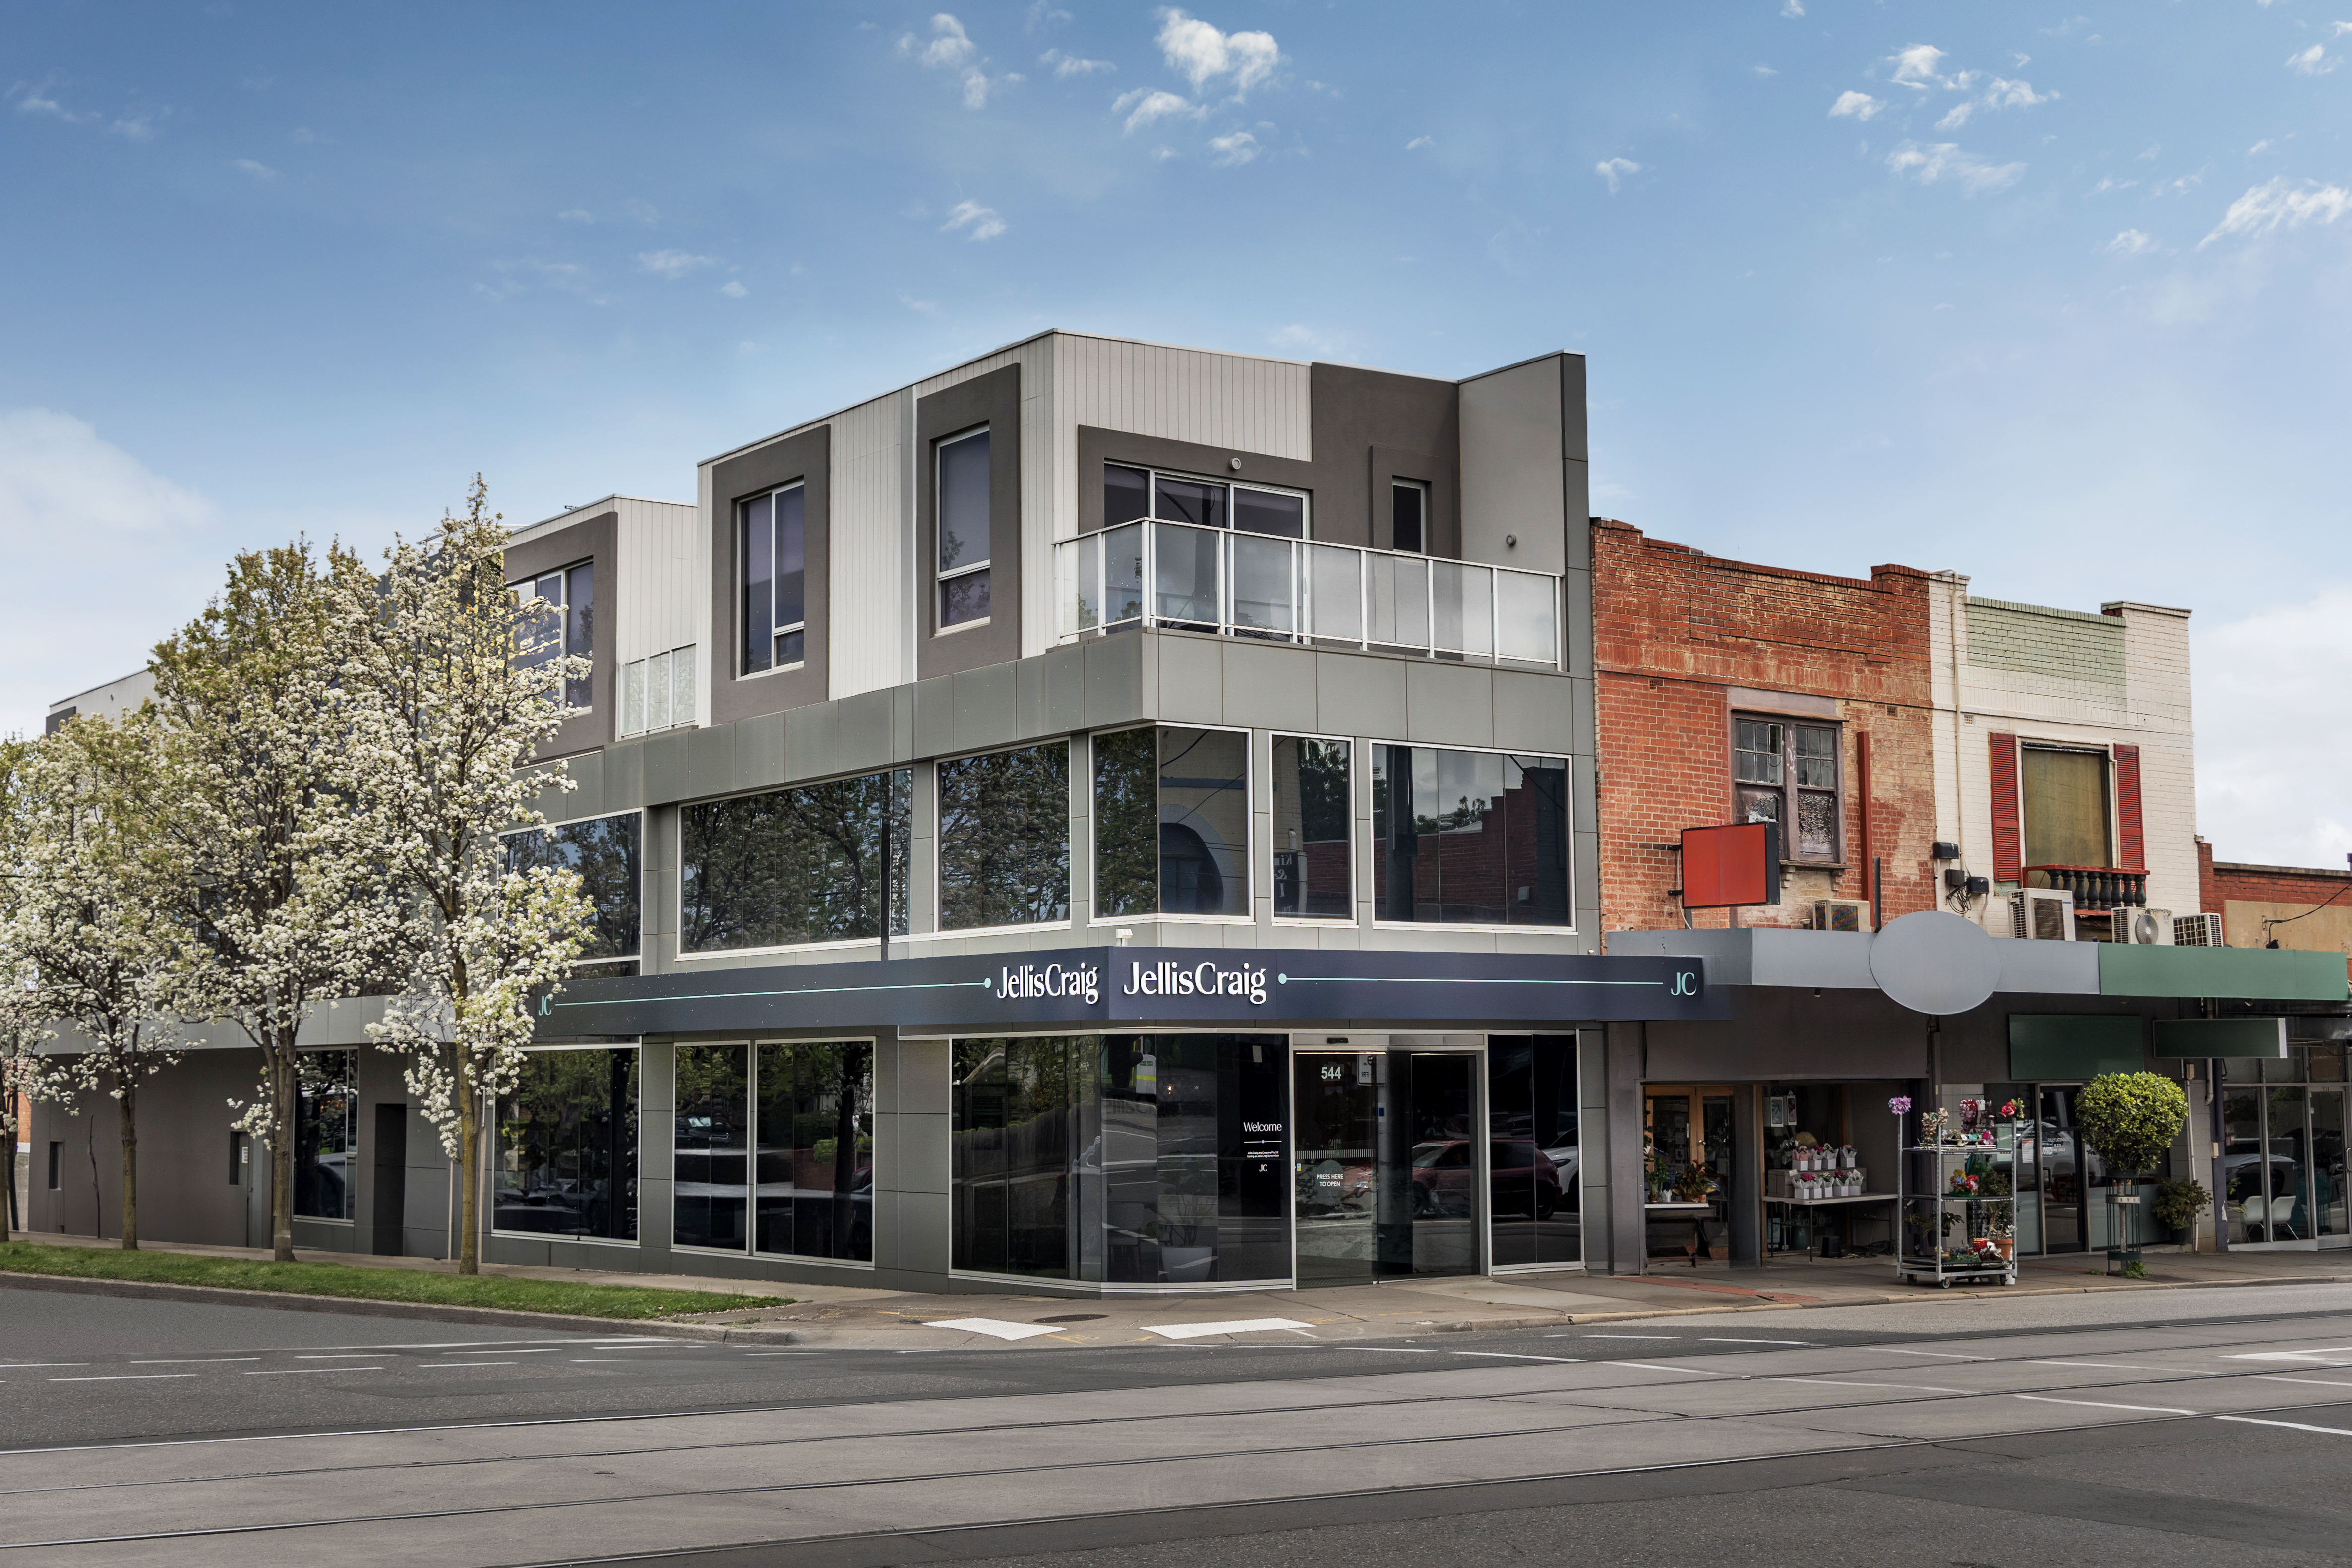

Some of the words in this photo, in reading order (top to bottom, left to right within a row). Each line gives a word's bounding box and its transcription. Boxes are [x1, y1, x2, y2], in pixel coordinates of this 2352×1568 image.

[1671, 972, 1697, 996] JC
[539, 994, 552, 1016] JC
[1321, 1066, 1341, 1079] 544
[1243, 1122, 1282, 1132] Welcome
